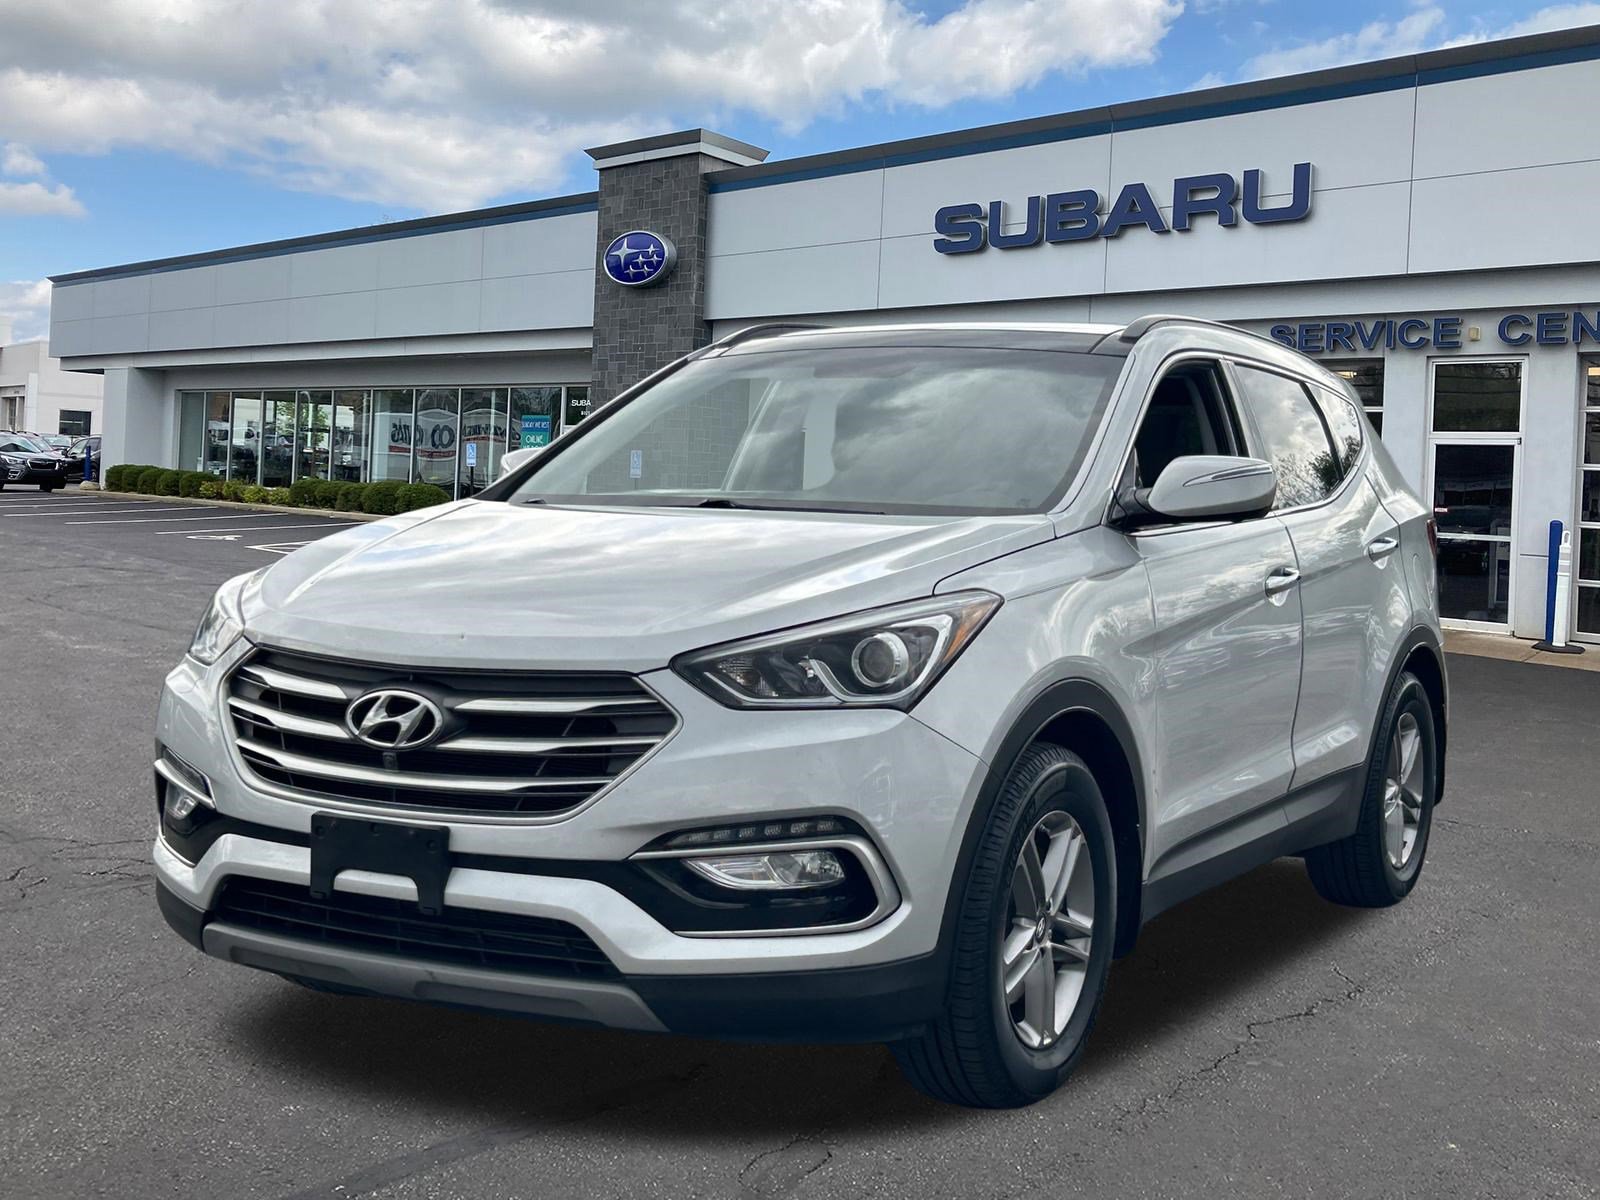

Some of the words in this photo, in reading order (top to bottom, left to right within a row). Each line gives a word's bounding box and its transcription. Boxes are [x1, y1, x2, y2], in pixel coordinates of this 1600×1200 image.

[933, 161, 1313, 256] SUBARU
[1270, 317, 1463, 351] SERVICE
[1497, 311, 1600, 346] CEN
